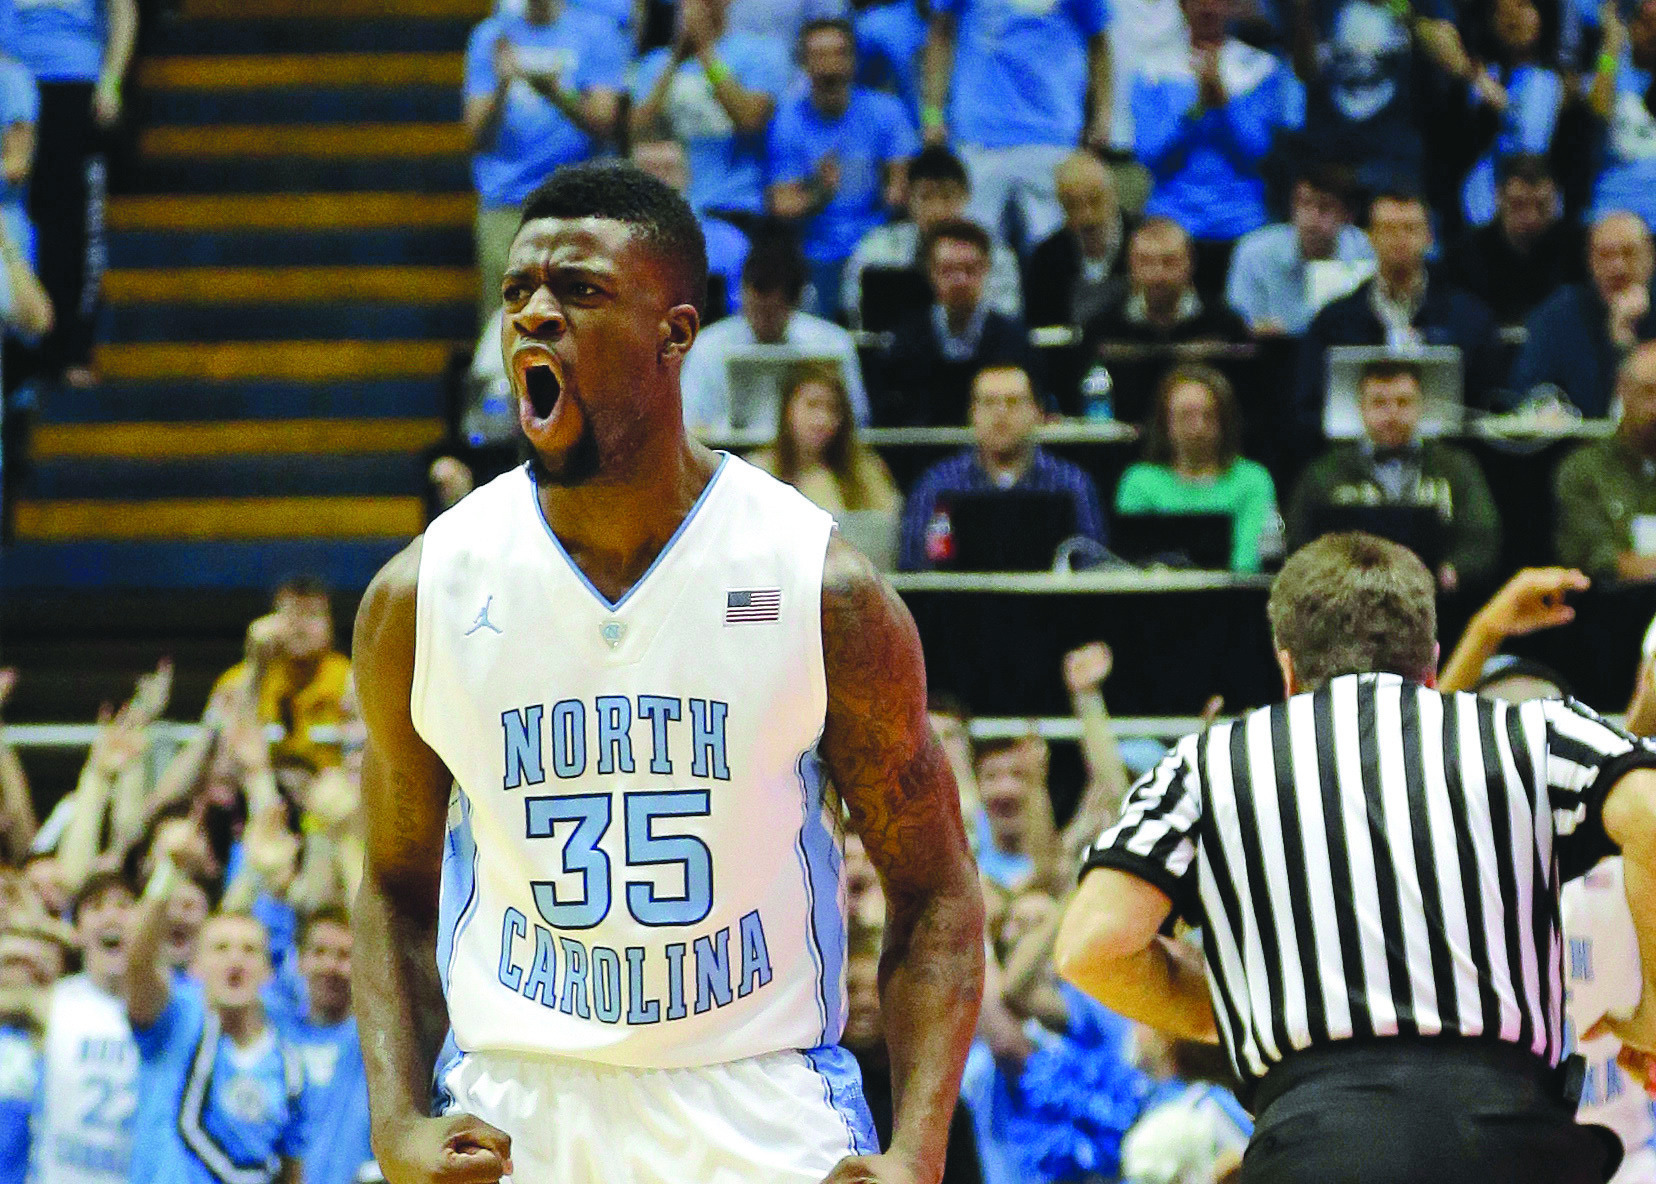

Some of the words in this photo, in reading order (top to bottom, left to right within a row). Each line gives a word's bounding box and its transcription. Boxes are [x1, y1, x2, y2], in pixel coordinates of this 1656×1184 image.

[501, 695, 731, 790] NORTH
[524, 788, 714, 931] 35
[499, 905, 773, 1026] CAROLINA
